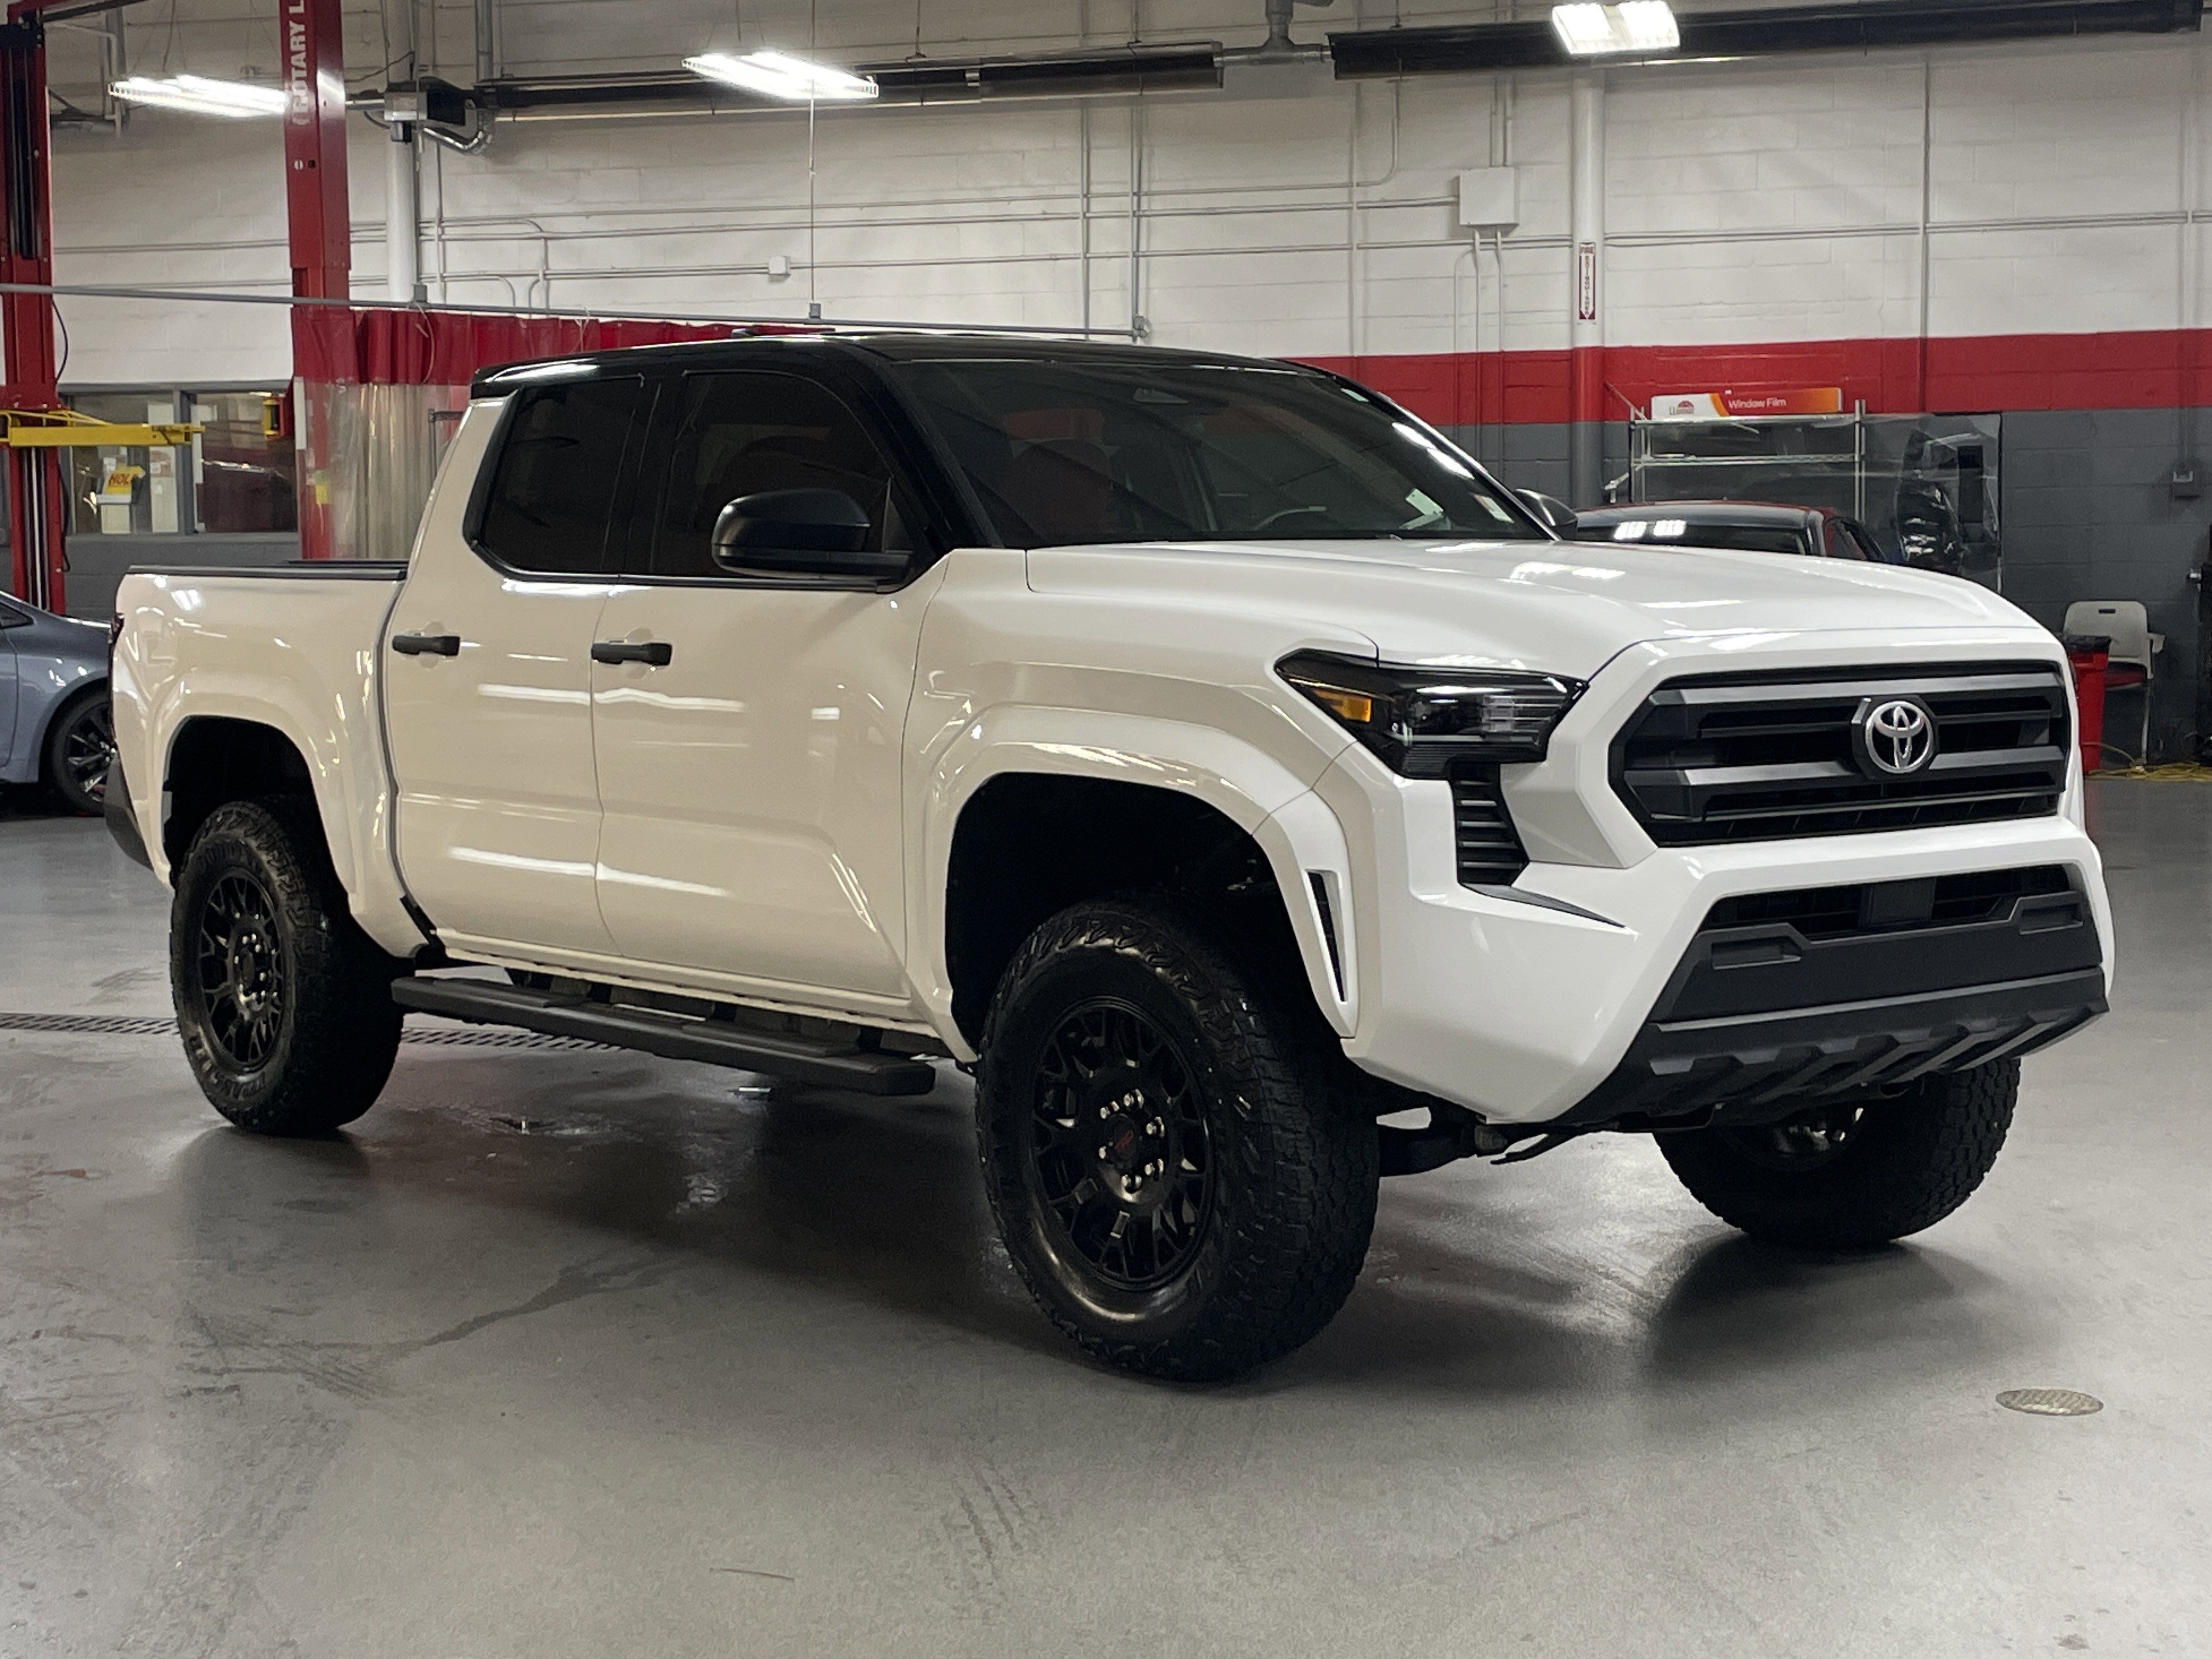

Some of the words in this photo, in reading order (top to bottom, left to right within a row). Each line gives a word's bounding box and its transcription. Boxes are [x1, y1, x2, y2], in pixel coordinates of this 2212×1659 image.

[289, 20, 308, 113] ROTARY
[1728, 398, 1765, 409] Window
[1767, 397, 1787, 407] Film
